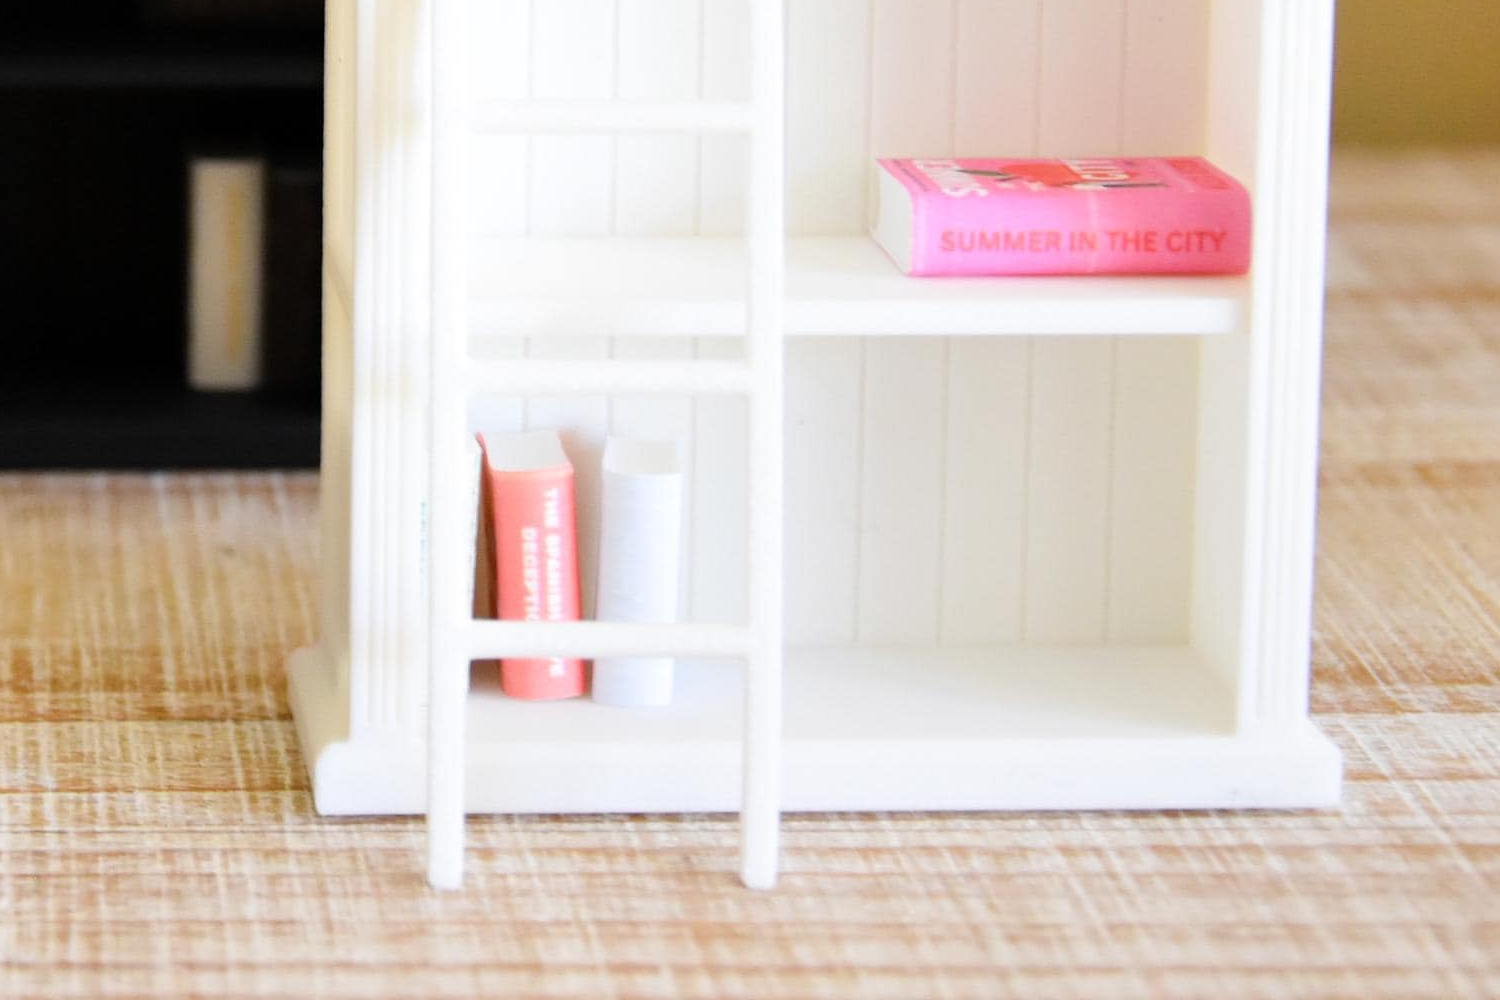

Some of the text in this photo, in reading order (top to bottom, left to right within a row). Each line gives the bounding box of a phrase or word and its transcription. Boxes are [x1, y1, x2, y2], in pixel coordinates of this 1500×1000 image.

[940, 229, 1228, 254] SUMMER IN THE CITY
[543, 488, 560, 529] THE
[520, 527, 541, 622] DECEPTIO
